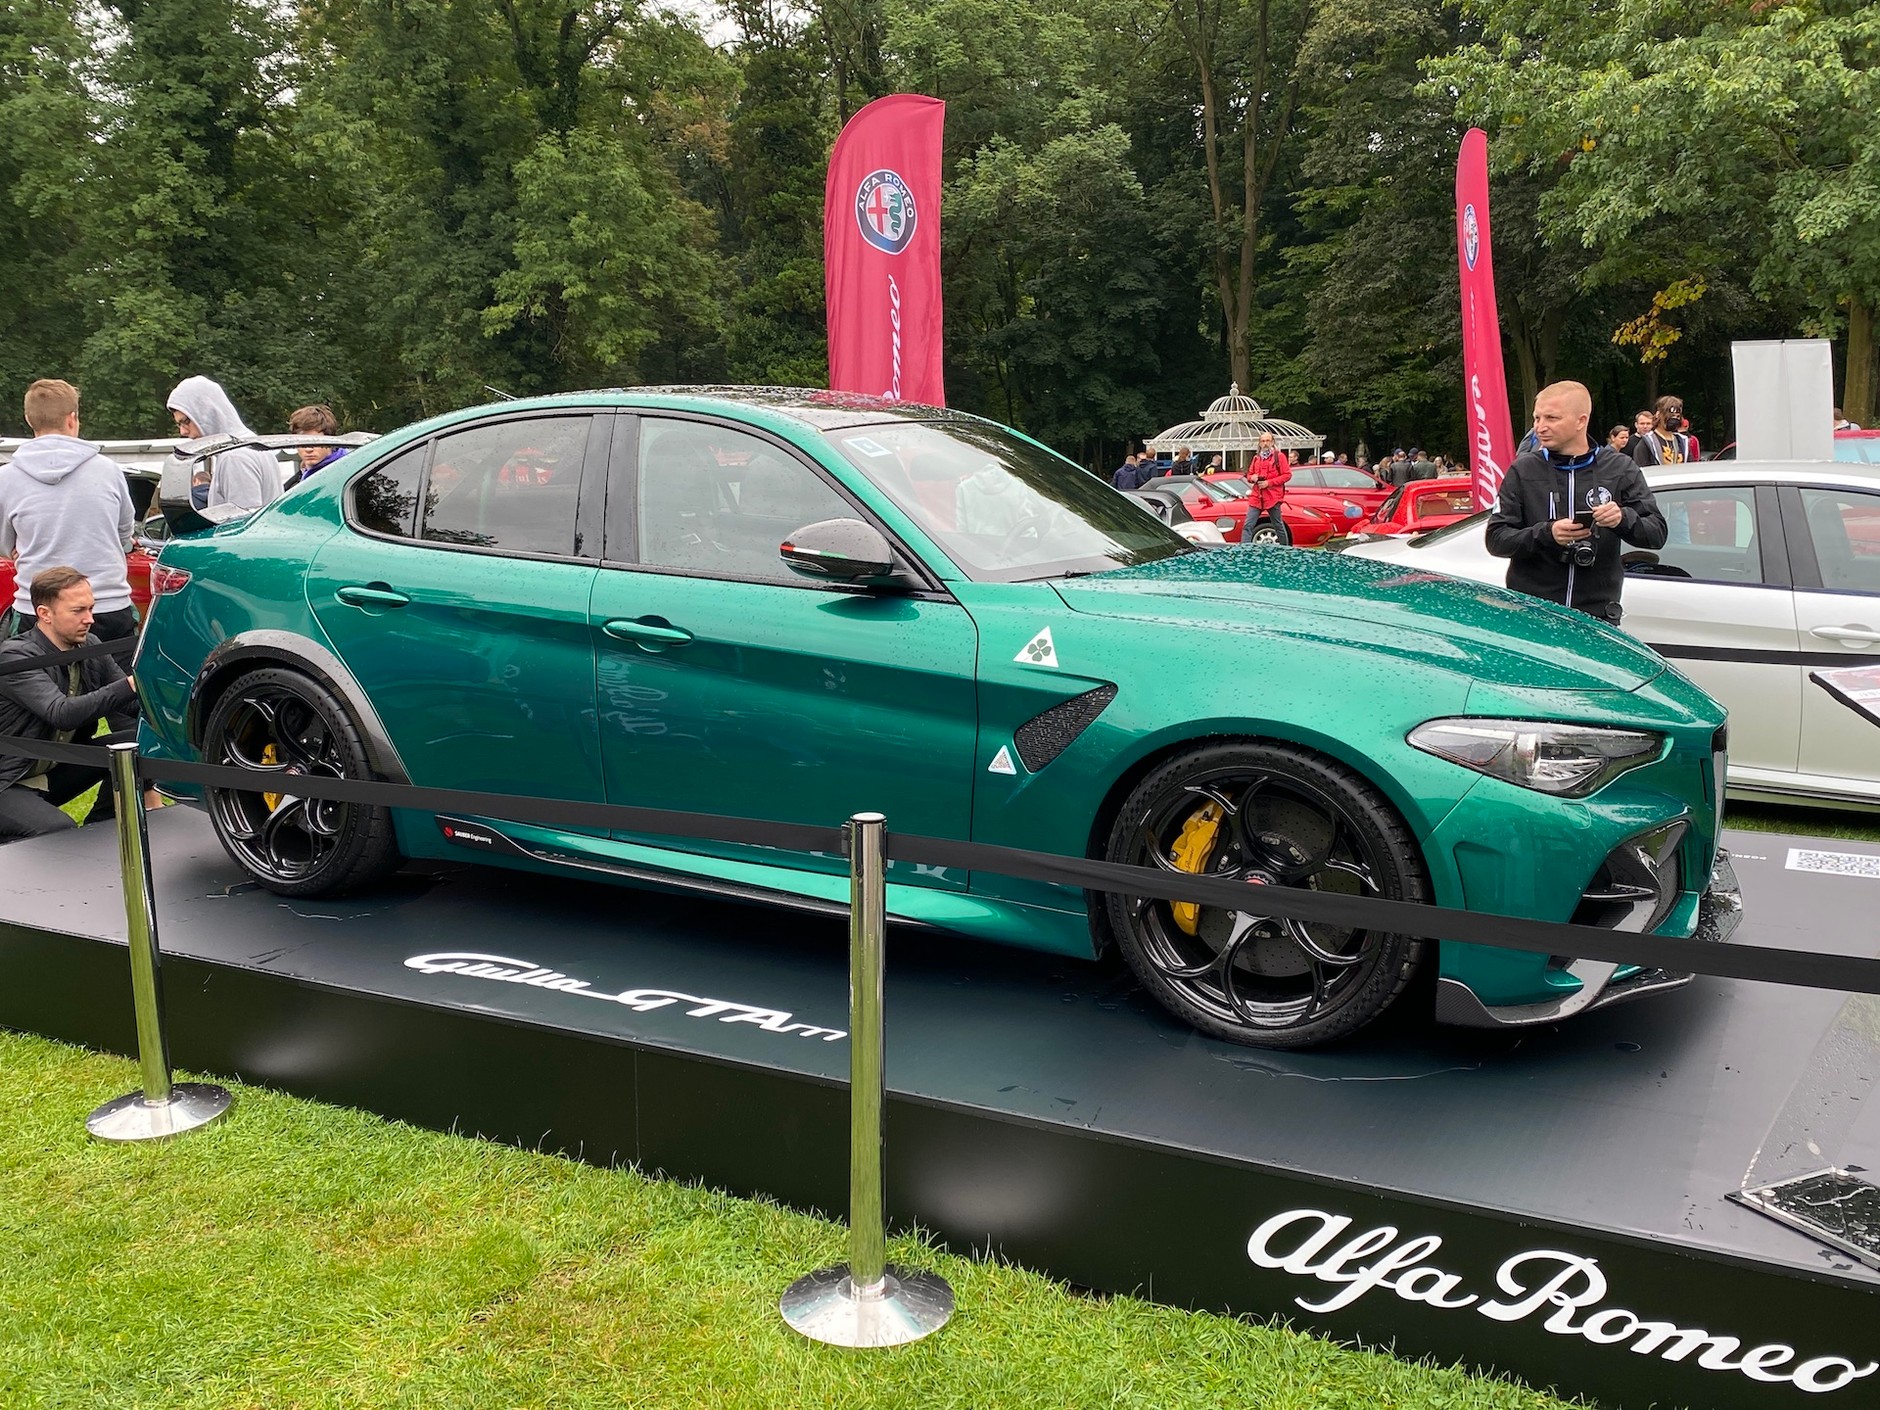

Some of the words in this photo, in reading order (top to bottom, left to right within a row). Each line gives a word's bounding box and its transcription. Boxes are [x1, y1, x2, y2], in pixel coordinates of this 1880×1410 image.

[858, 176, 880, 212] ALFA
[884, 173, 915, 218] ROMEO
[882, 274, 901, 400] omeo
[403, 952, 613, 1000] Giulia
[616, 988, 848, 1042] GTAm
[1246, 1208, 1480, 1314] Alfa
[1477, 1249, 1879, 1393] Romeo
